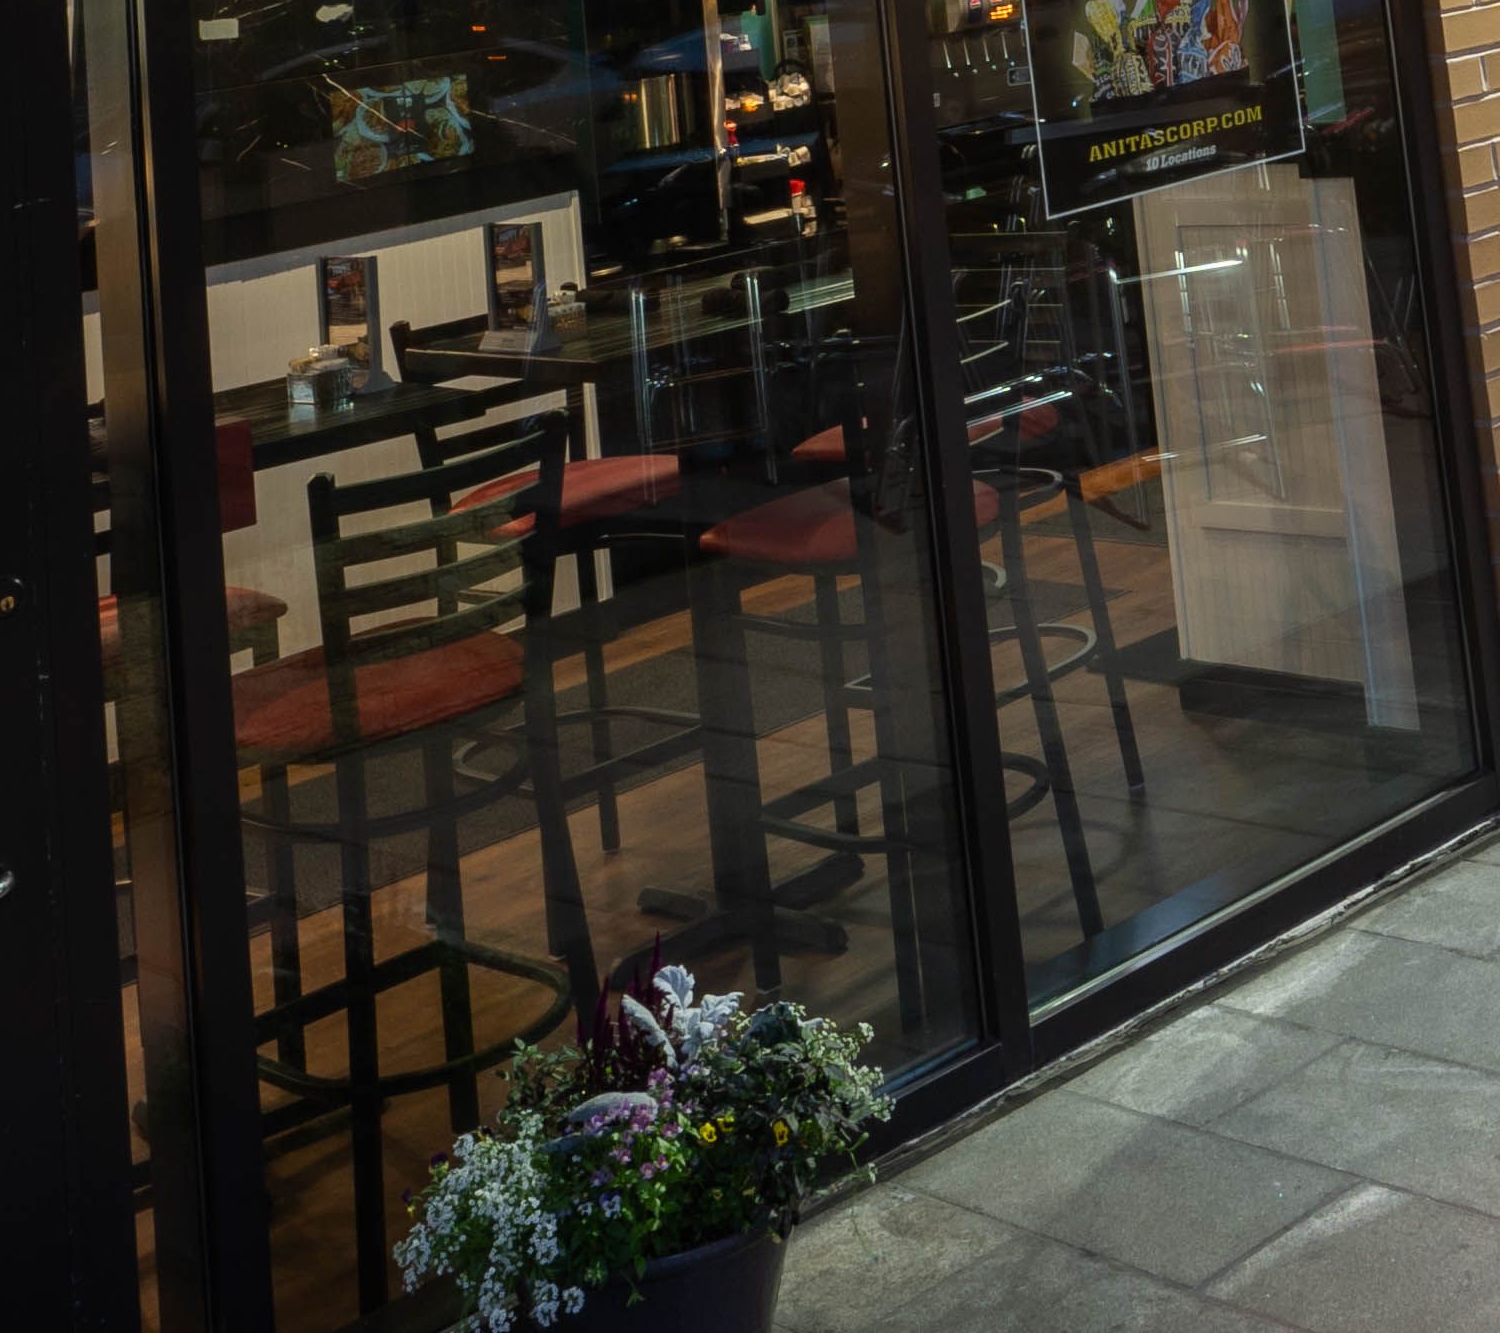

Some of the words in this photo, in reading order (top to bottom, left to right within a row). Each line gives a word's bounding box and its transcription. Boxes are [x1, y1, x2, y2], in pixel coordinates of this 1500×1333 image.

[1089, 105, 1263, 162] ANITASCORP.COM
[1146, 158, 1159, 171] 10
[1160, 145, 1217, 167] Locations
